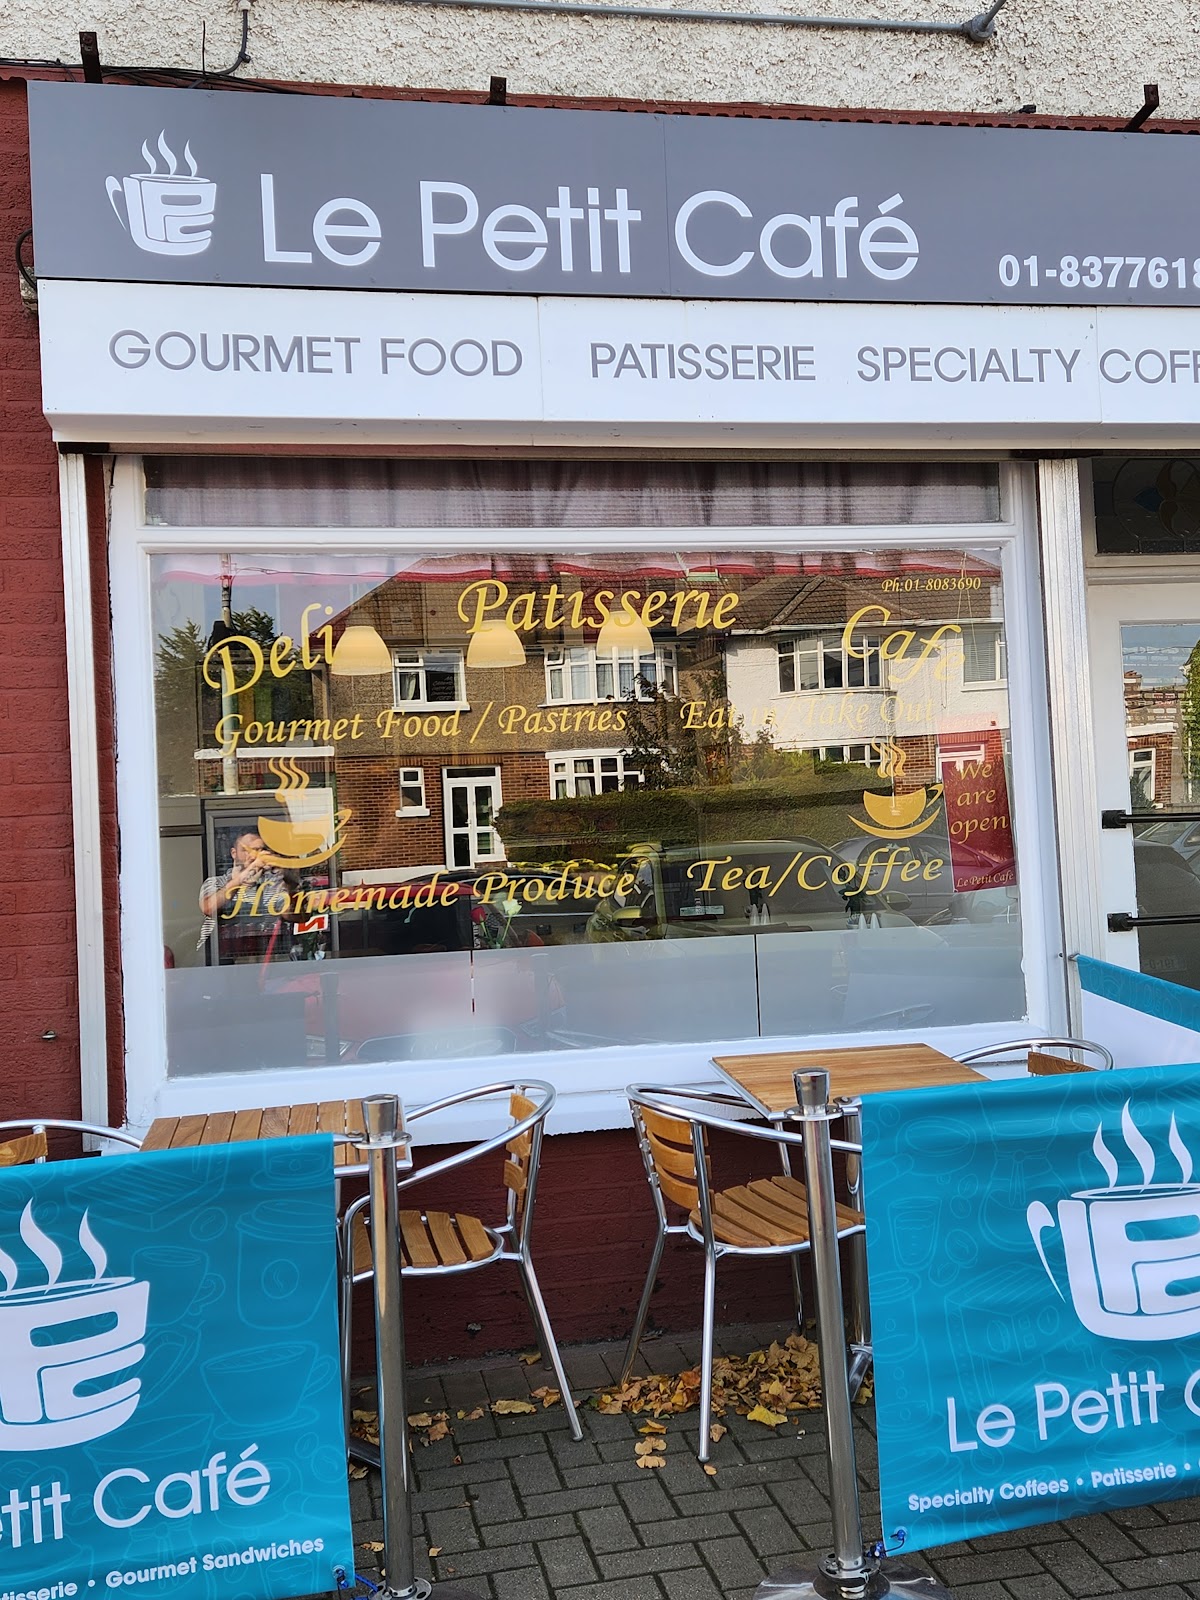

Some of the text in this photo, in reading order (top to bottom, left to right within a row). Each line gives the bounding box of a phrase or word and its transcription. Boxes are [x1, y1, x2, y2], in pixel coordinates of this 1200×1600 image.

[260, 173, 920, 281] Le Petit Café
[108, 329, 361, 374] GOURMET
[381, 337, 523, 376] FOOD
[590, 342, 816, 382] PATISSERIE
[857, 345, 1081, 383] SPECIALTY
[458, 579, 739, 634] Patisserie
[203, 602, 334, 698] Deli
[214, 713, 363, 756] Gourmet
[376, 703, 462, 738] Food
[498, 703, 628, 734] Pastries
[680, 700, 736, 729] Eat
[880, 695, 936, 724] Out
[958, 762, 993, 780] We
[957, 789, 996, 807] are
[950, 814, 1009, 844] open
[220, 862, 635, 919] Homemade Produce
[687, 847, 944, 896] Tea/Coffee
[956, 877, 969, 888] Le
[970, 873, 992, 885] Petit
[946, 1397, 1016, 1452] Le
[1035, 1371, 1165, 1440] Petit
[0, 1443, 271, 1548] tit Café
[908, 1462, 1177, 1512] Specialty Coffees Patisserie
[106, 1558, 198, 1588] Gourmet
[203, 1537, 324, 1571] Sandwiches
